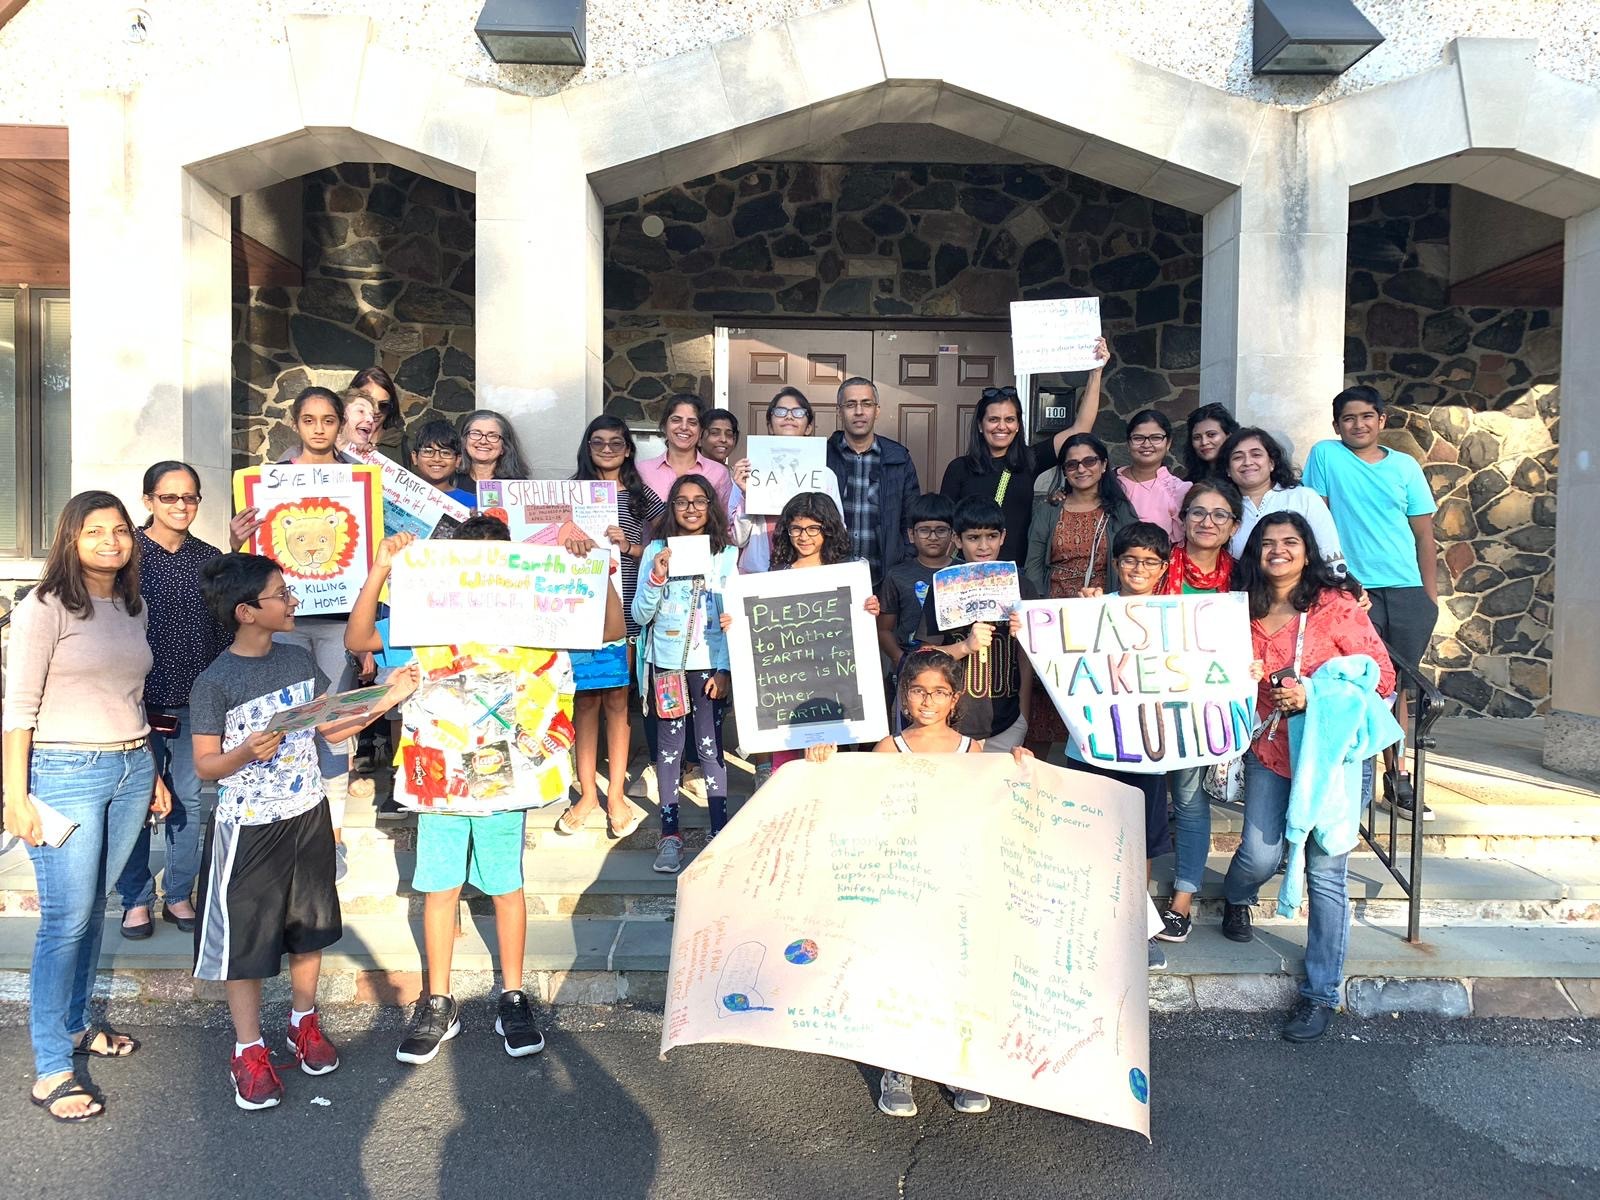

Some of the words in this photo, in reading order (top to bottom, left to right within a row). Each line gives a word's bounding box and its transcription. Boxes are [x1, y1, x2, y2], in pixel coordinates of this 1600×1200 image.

[1048, 408, 1064, 417] 100
[384, 465, 396, 476] on
[394, 468, 427, 496] PLASTIC
[427, 488, 443, 505] but
[480, 481, 496, 490] LIFE
[750, 469, 823, 489] SAVE
[402, 494, 411, 505] in
[411, 498, 427, 517] it!
[507, 553, 565, 574] Earth
[571, 558, 605, 575] will
[305, 582, 348, 594] KILLING
[459, 571, 531, 589] Without
[534, 576, 595, 598] Earth,
[314, 596, 349, 610] HOME
[534, 595, 585, 613] NOT
[752, 598, 838, 626] PLEDGE
[965, 600, 996, 613] 2050
[1027, 600, 1217, 654] PLASTIC
[755, 637, 775, 653] to
[780, 630, 843, 649] Mother
[830, 646, 853, 660] for
[757, 671, 808, 687] there
[815, 666, 831, 677] is
[836, 659, 857, 677] No
[760, 690, 815, 708] Other
[1081, 696, 1253, 763] LLUTION
[415, 756, 423, 786] Doritos
[1037, 804, 1046, 818] to
[1080, 804, 1104, 817] own
[896, 834, 918, 848] and
[884, 847, 919, 862] things
[832, 862, 851, 871] we
[858, 862, 881, 870] use
[889, 858, 932, 876] plastic
[1013, 954, 1040, 977] There
[1080, 981, 1093, 998] too
[787, 1006, 806, 1017] We
[791, 1019, 818, 1029] save
